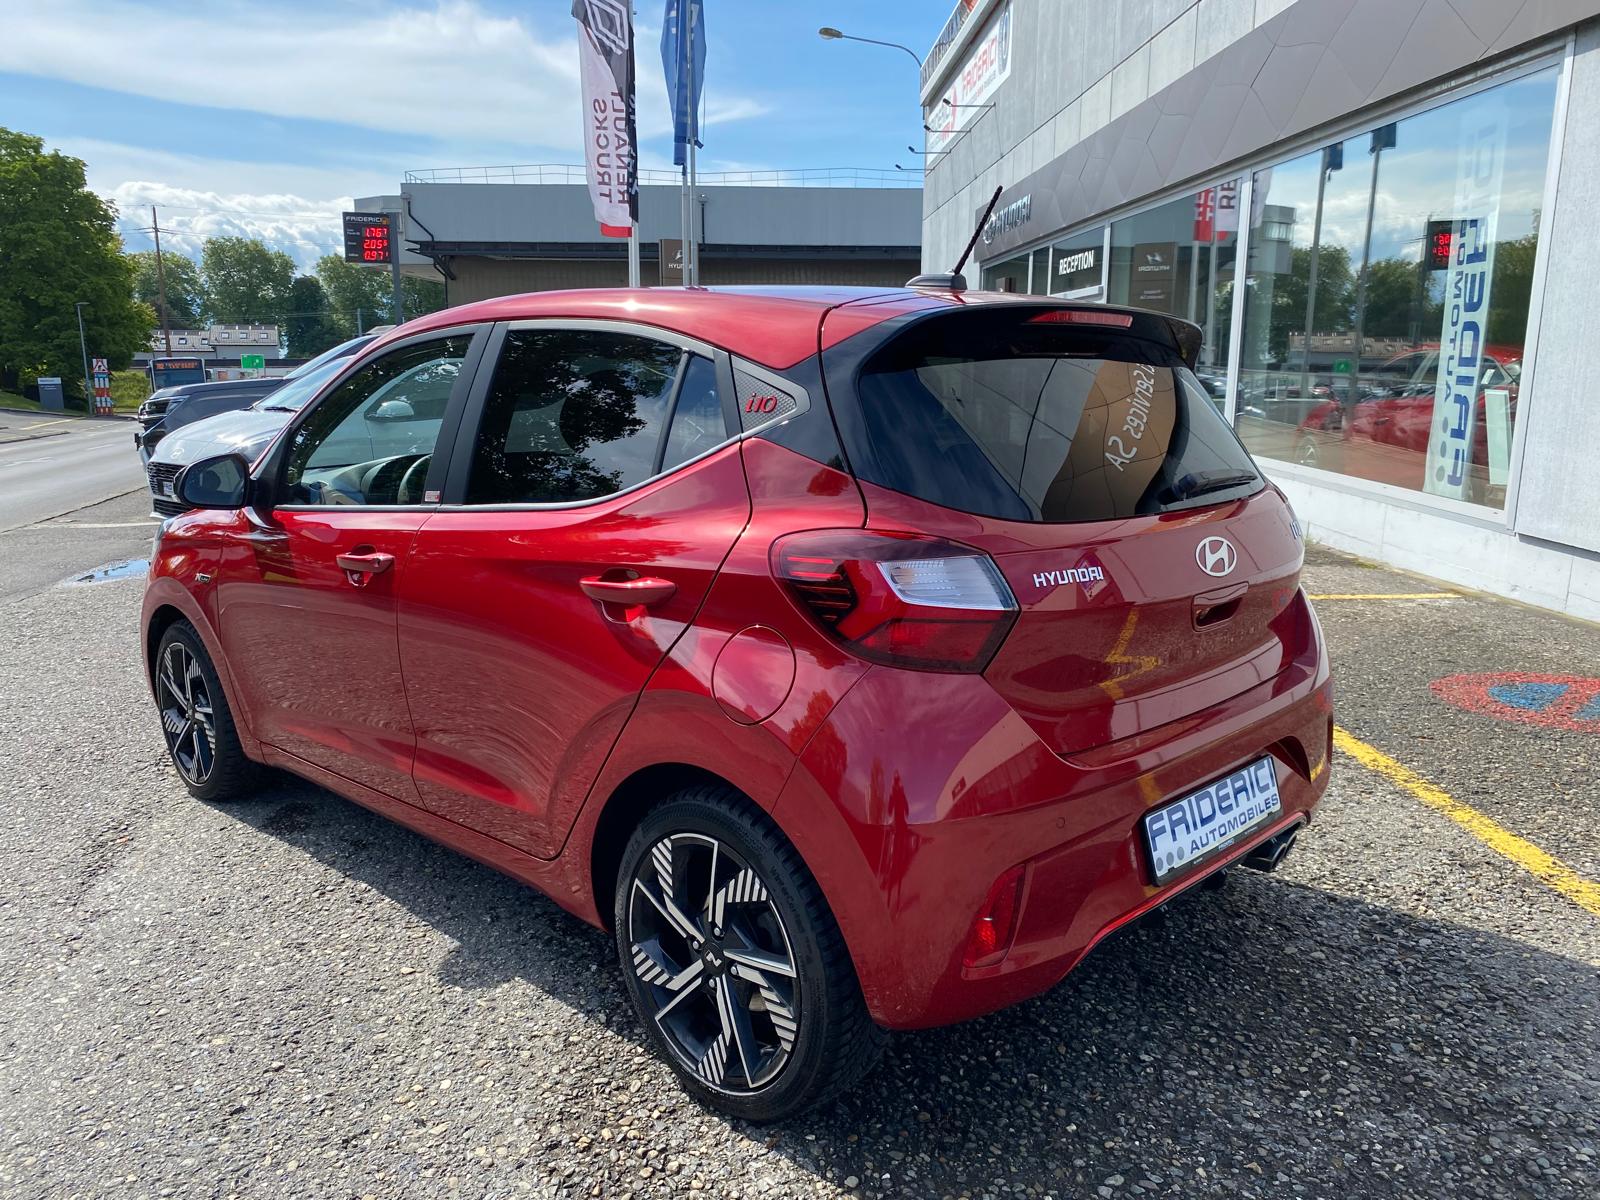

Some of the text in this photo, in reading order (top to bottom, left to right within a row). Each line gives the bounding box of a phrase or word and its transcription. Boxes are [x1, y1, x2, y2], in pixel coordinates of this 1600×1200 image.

[1059, 250, 1094, 275] RECEPTION
[745, 392, 777, 413] i10
[1033, 566, 1104, 588] HYUNDAI
[1148, 758, 1276, 852] FRIDERICI
[1190, 793, 1278, 855] AUTOMOBILES
